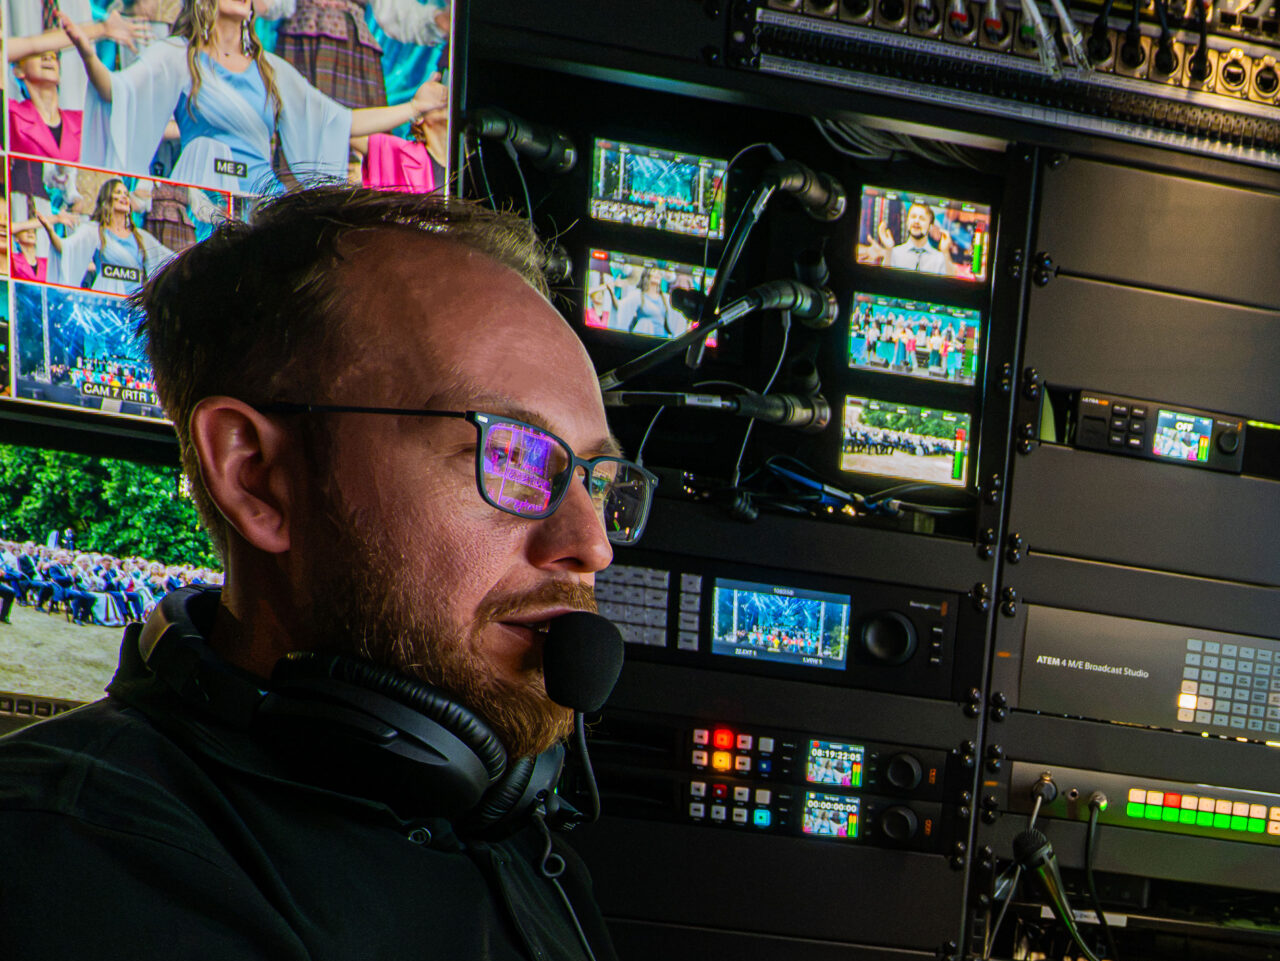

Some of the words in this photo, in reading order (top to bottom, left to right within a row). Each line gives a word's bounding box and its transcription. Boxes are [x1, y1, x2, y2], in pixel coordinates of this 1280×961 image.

[217, 161, 235, 174] ME
[236, 164, 244, 175] 2
[104, 265, 137, 280] CAM3
[83, 383, 110, 397] CAM
[112, 387, 120, 398] 7
[121, 388, 147, 403] (RTR
[1175, 421, 1194, 432] OFF
[1036, 655, 1060, 667] ATEM
[1061, 658, 1067, 667] 4
[1068, 660, 1084, 670] M/E
[1084, 661, 1122, 675] Broadcast
[1124, 667, 1150, 678] Studio
[807, 799, 858, 813] 00:00:00:00
